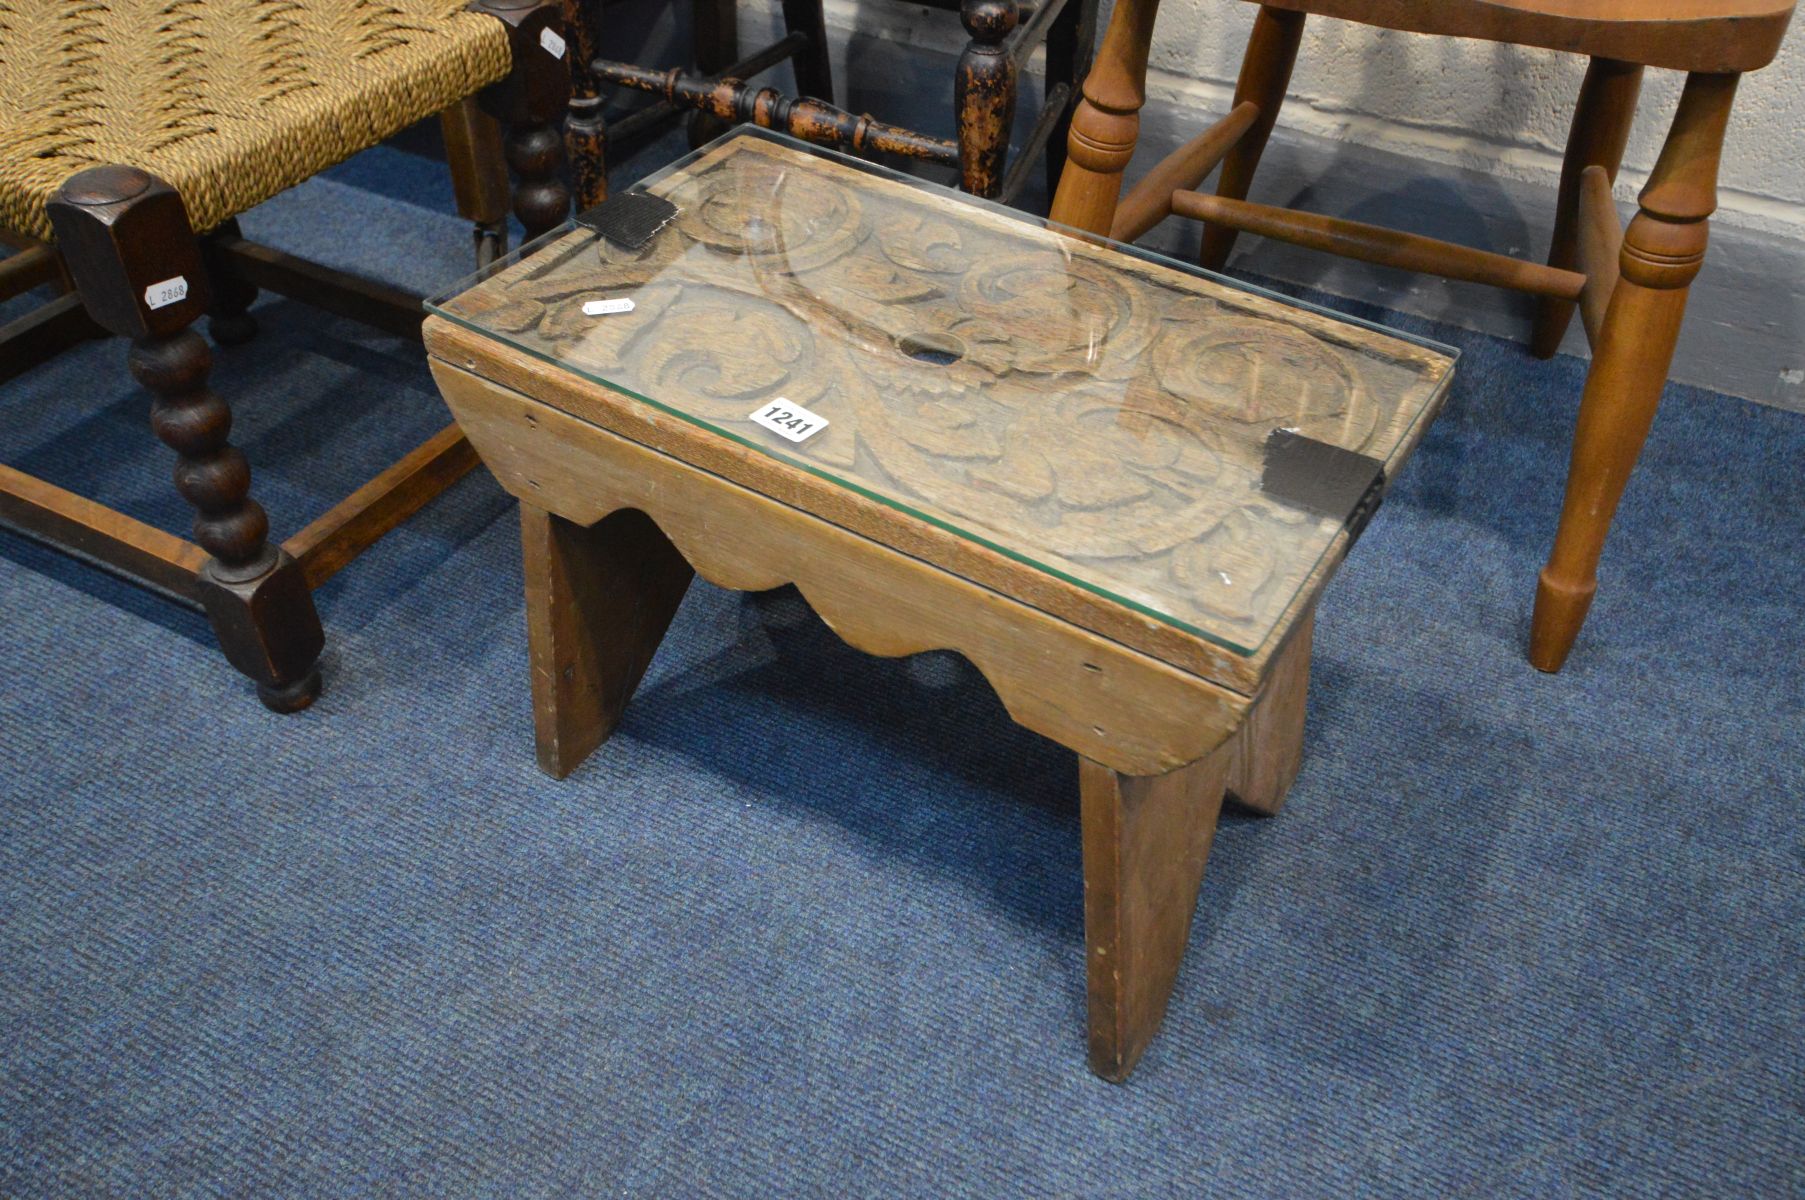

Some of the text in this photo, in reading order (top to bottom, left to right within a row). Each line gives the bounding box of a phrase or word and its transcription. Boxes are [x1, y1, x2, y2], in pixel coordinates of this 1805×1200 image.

[149, 284, 185, 306] L 2868
[764, 406, 814, 434] 1241
